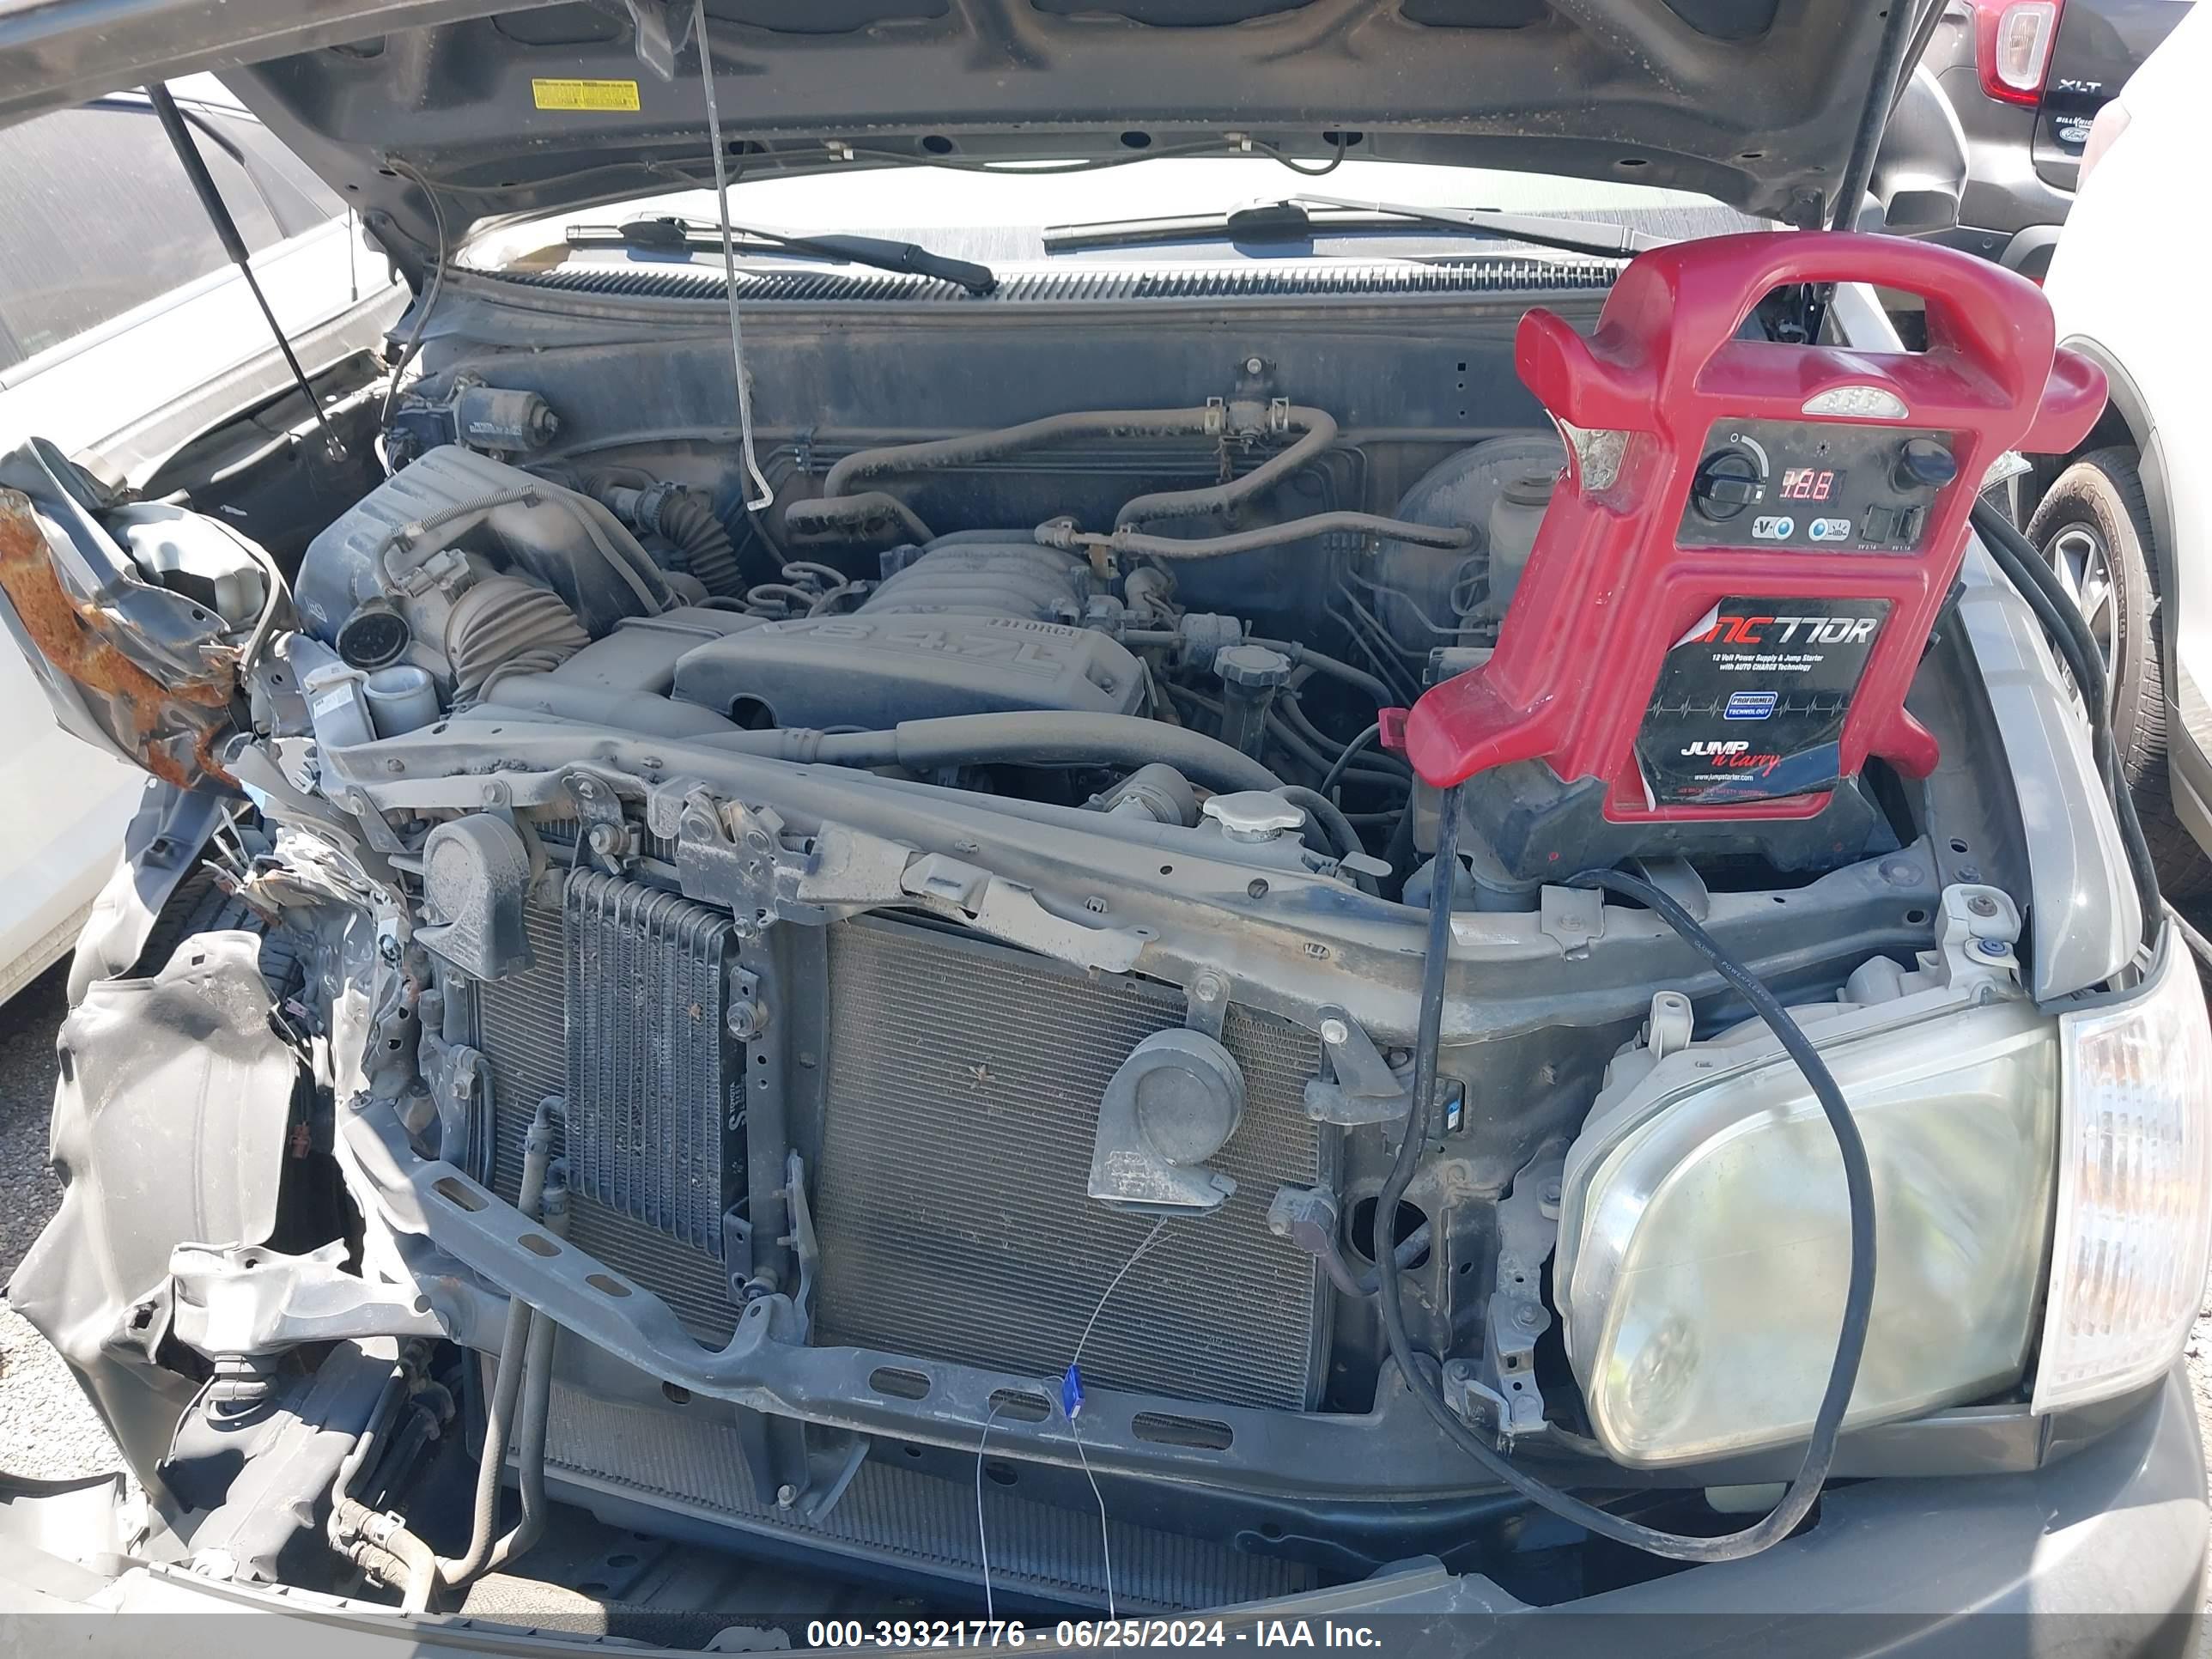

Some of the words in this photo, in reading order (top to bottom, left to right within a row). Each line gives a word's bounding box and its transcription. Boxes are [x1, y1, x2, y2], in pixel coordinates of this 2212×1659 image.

[2058, 79, 2102, 93] XLT
[1756, 653, 1778, 663] Supply
[1784, 653, 1802, 663] Jump
[1778, 663, 1812, 672] Technology
[1680, 741, 1749, 756] JUMP
[1729, 751, 1781, 777] Carry
[1694, 774, 1753, 783] www.jumpstarter.com
